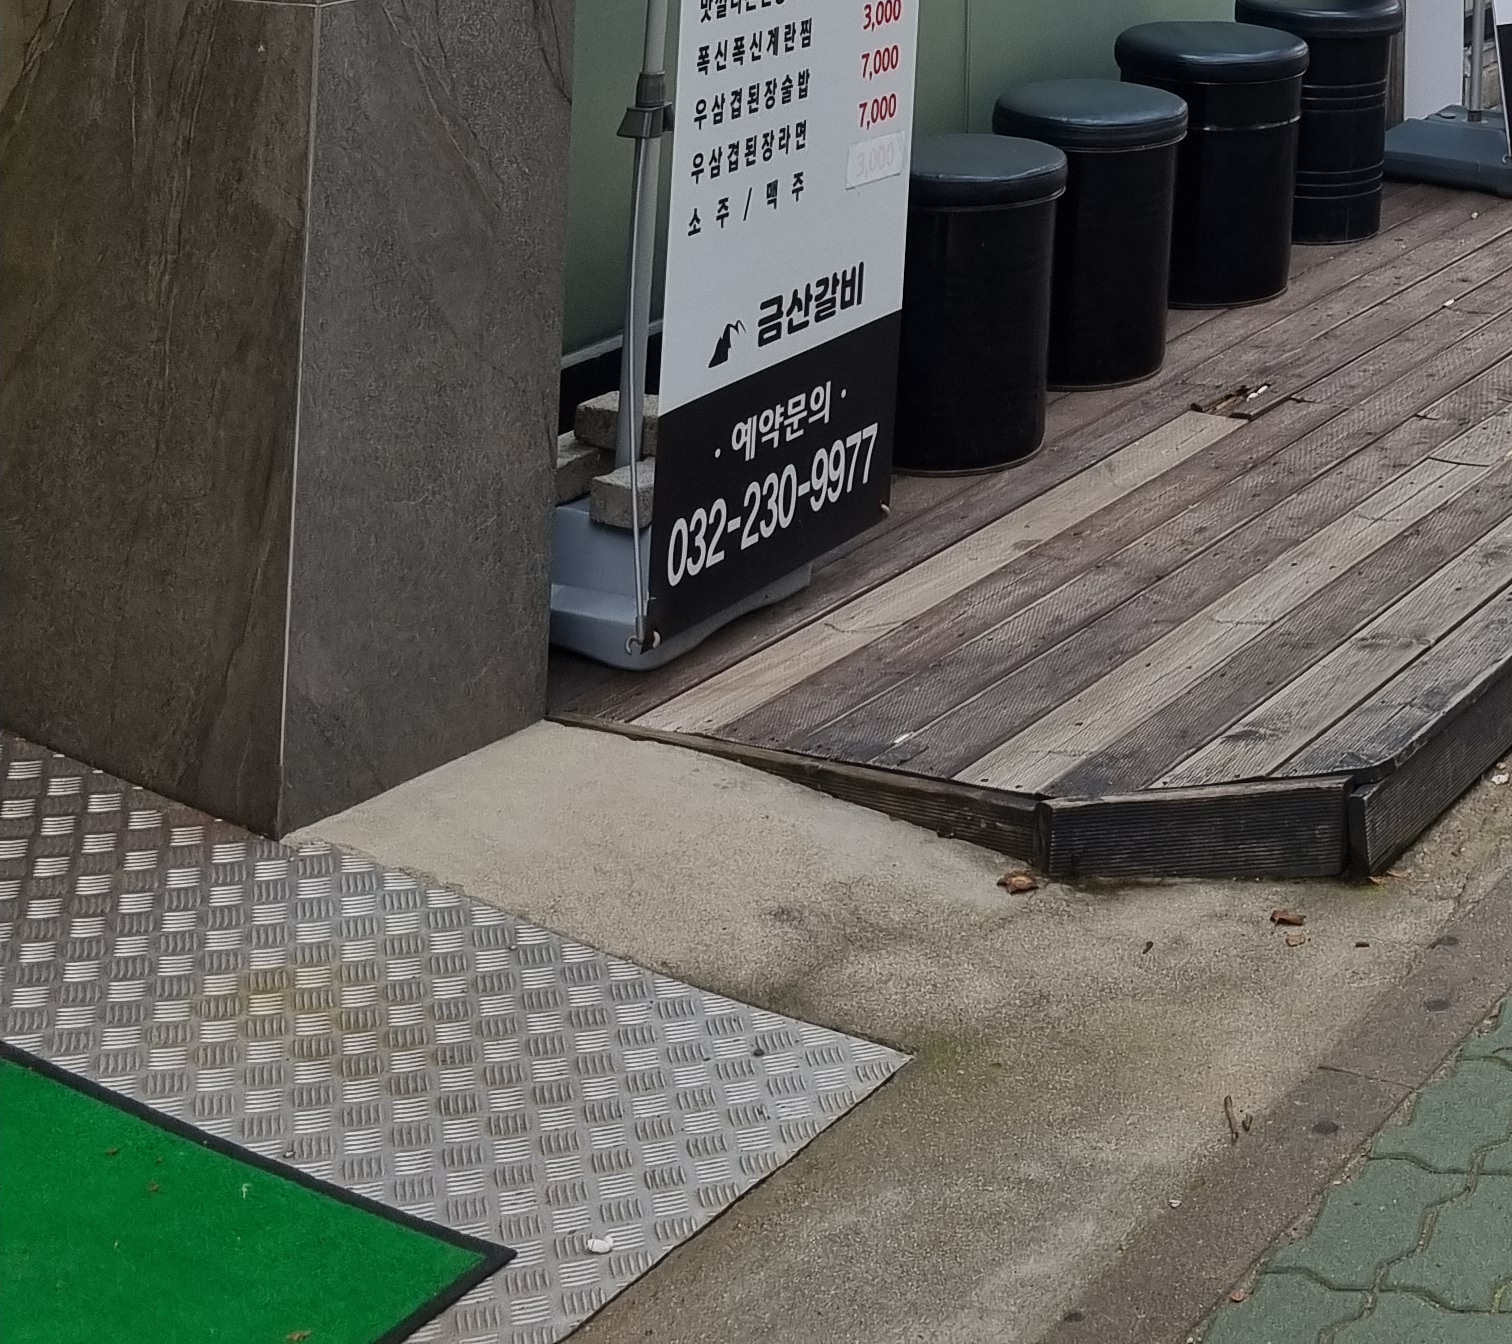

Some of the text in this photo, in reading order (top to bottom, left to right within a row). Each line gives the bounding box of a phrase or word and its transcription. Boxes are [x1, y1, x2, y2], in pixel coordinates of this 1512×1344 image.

[693, 44, 899, 130] 우삼겹된장술밥 7,000
[690, 93, 898, 186] 우삼겹된장라면 7,000
[756, 261, 865, 348] 금산갈비
[730, 380, 832, 464] 예약문의
[666, 421, 879, 589] 032-230-9977
